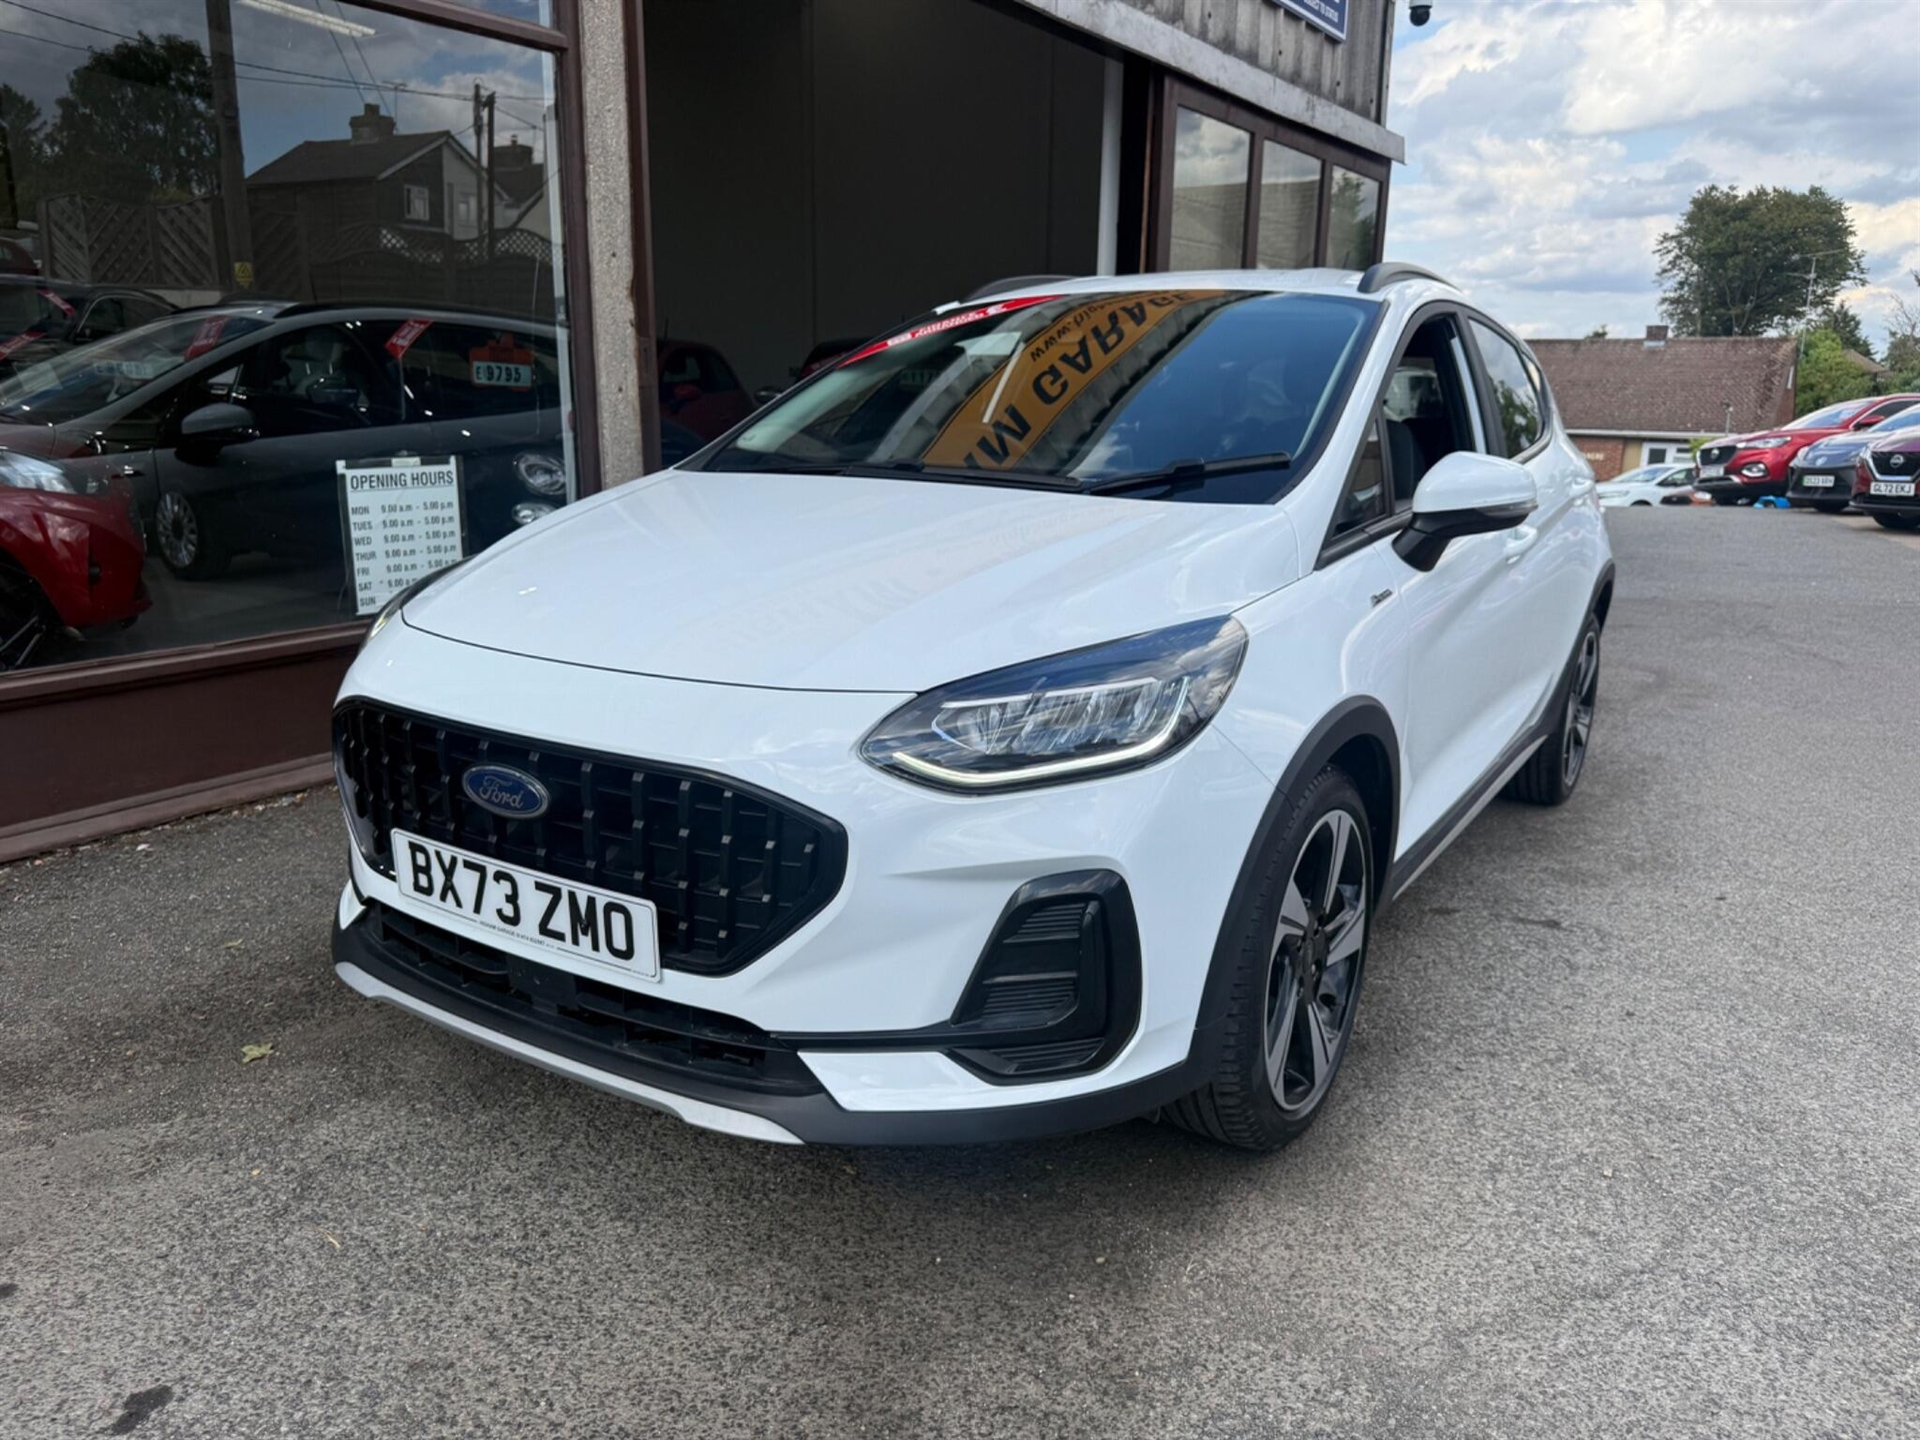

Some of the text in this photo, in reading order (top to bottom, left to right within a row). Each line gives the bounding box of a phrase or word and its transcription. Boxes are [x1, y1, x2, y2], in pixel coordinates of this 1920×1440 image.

[350, 470, 454, 490] OPENING HOURS
[1873, 483, 1894, 493] GL72
[351, 505, 370, 515] MON
[352, 521, 373, 531] TUES
[354, 536, 372, 546] WED
[355, 551, 377, 561] THUR
[357, 567, 370, 577] FRI
[358, 582, 372, 592] SAT
[360, 596, 376, 607] SUN
[479, 775, 524, 809] Ford
[408, 841, 635, 961] BX73 ZMO
